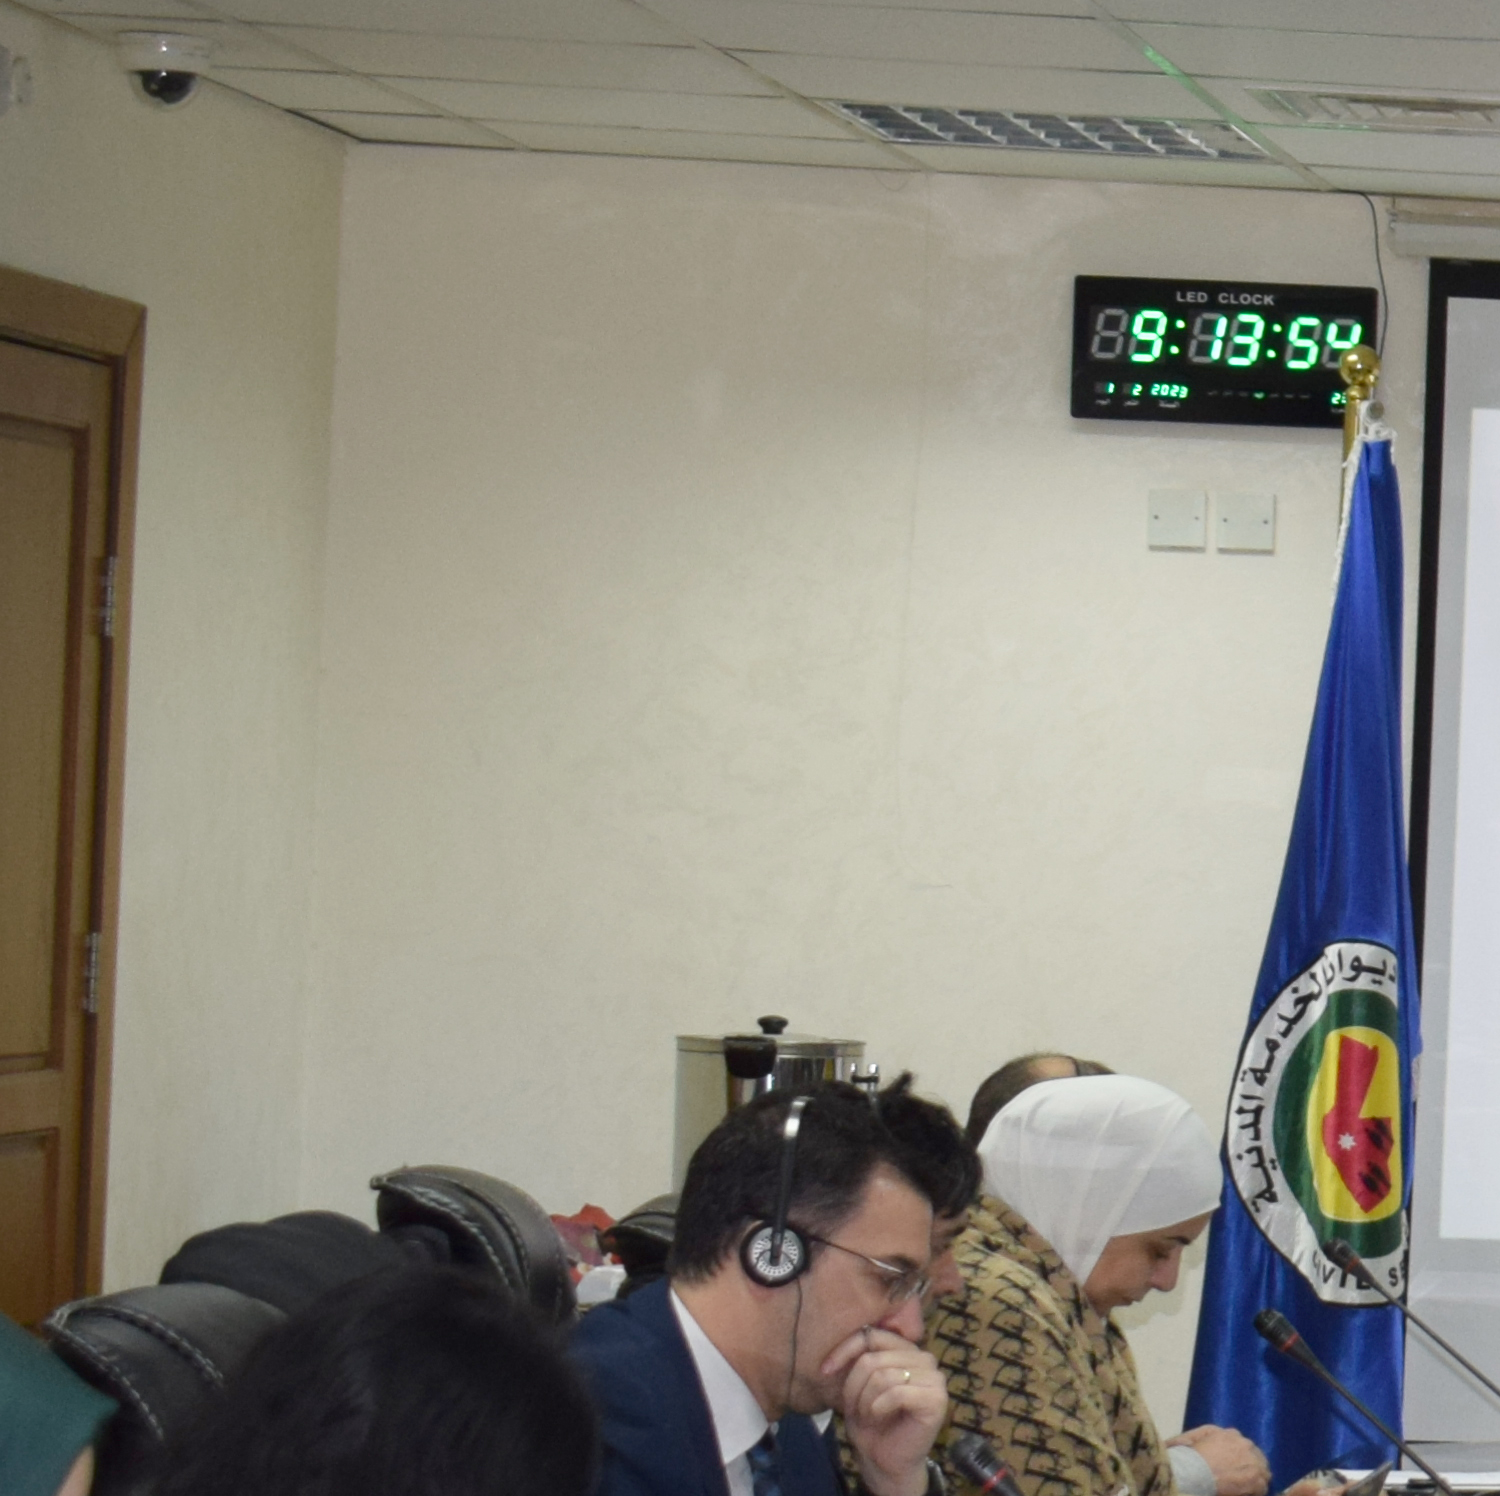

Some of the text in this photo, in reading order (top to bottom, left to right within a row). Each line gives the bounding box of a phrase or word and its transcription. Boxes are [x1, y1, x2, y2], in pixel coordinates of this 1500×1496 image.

[1176, 290, 1275, 306] LED CLOCK
[1234, 1094, 1280, 1214] المدنية
